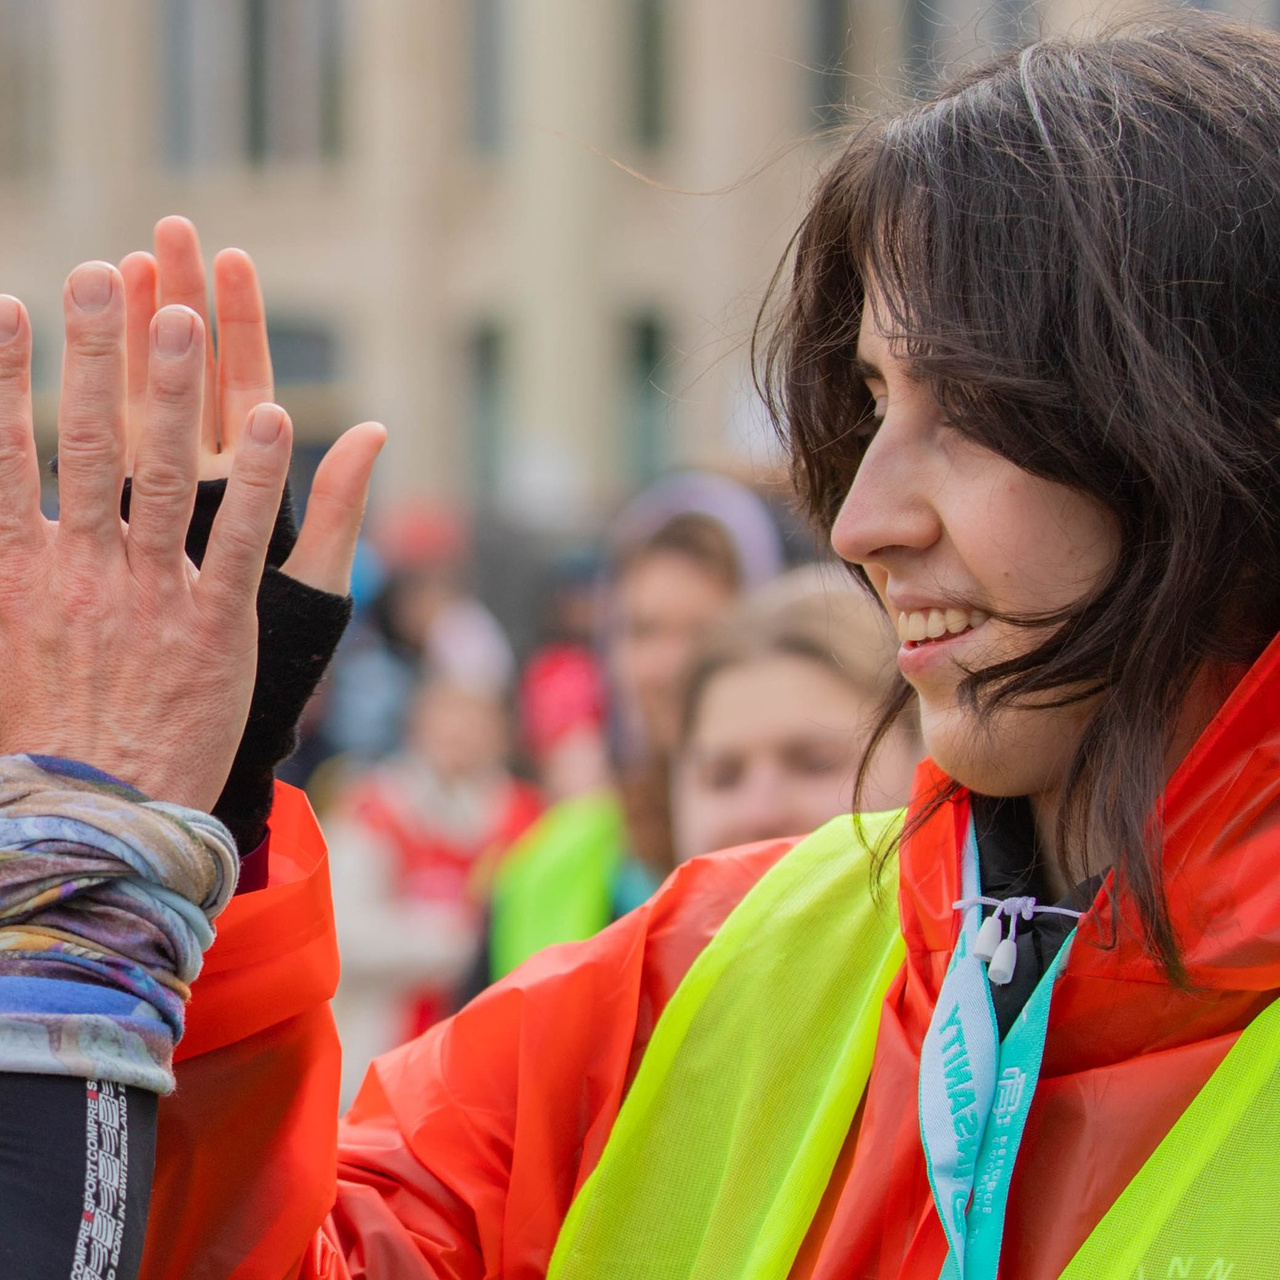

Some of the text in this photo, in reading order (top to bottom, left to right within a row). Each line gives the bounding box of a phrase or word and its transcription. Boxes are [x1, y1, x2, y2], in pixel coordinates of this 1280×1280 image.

[118, 1096, 129, 1201] SWITZERLAND
[117, 1205, 127, 1224] IN
[109, 1223, 125, 1268] BORN
